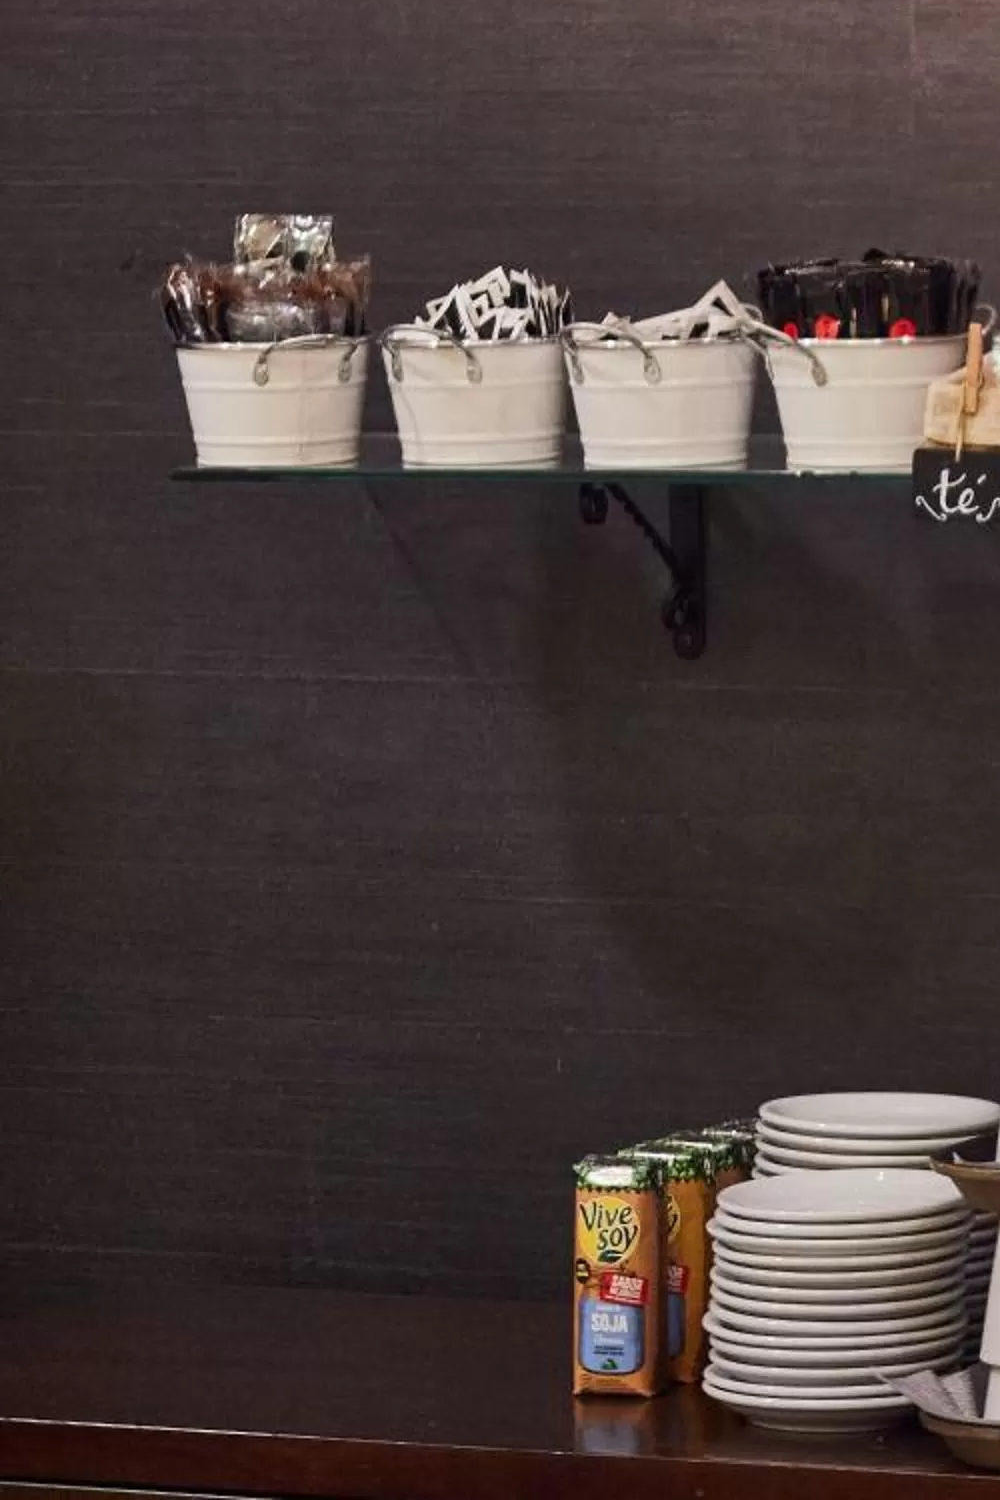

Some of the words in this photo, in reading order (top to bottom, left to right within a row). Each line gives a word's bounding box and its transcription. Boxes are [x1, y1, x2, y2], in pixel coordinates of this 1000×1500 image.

[932, 467, 985, 514] té
[580, 1202, 633, 1232] Vive
[597, 1225, 639, 1251] soy
[591, 1313, 628, 1333] SOJA
